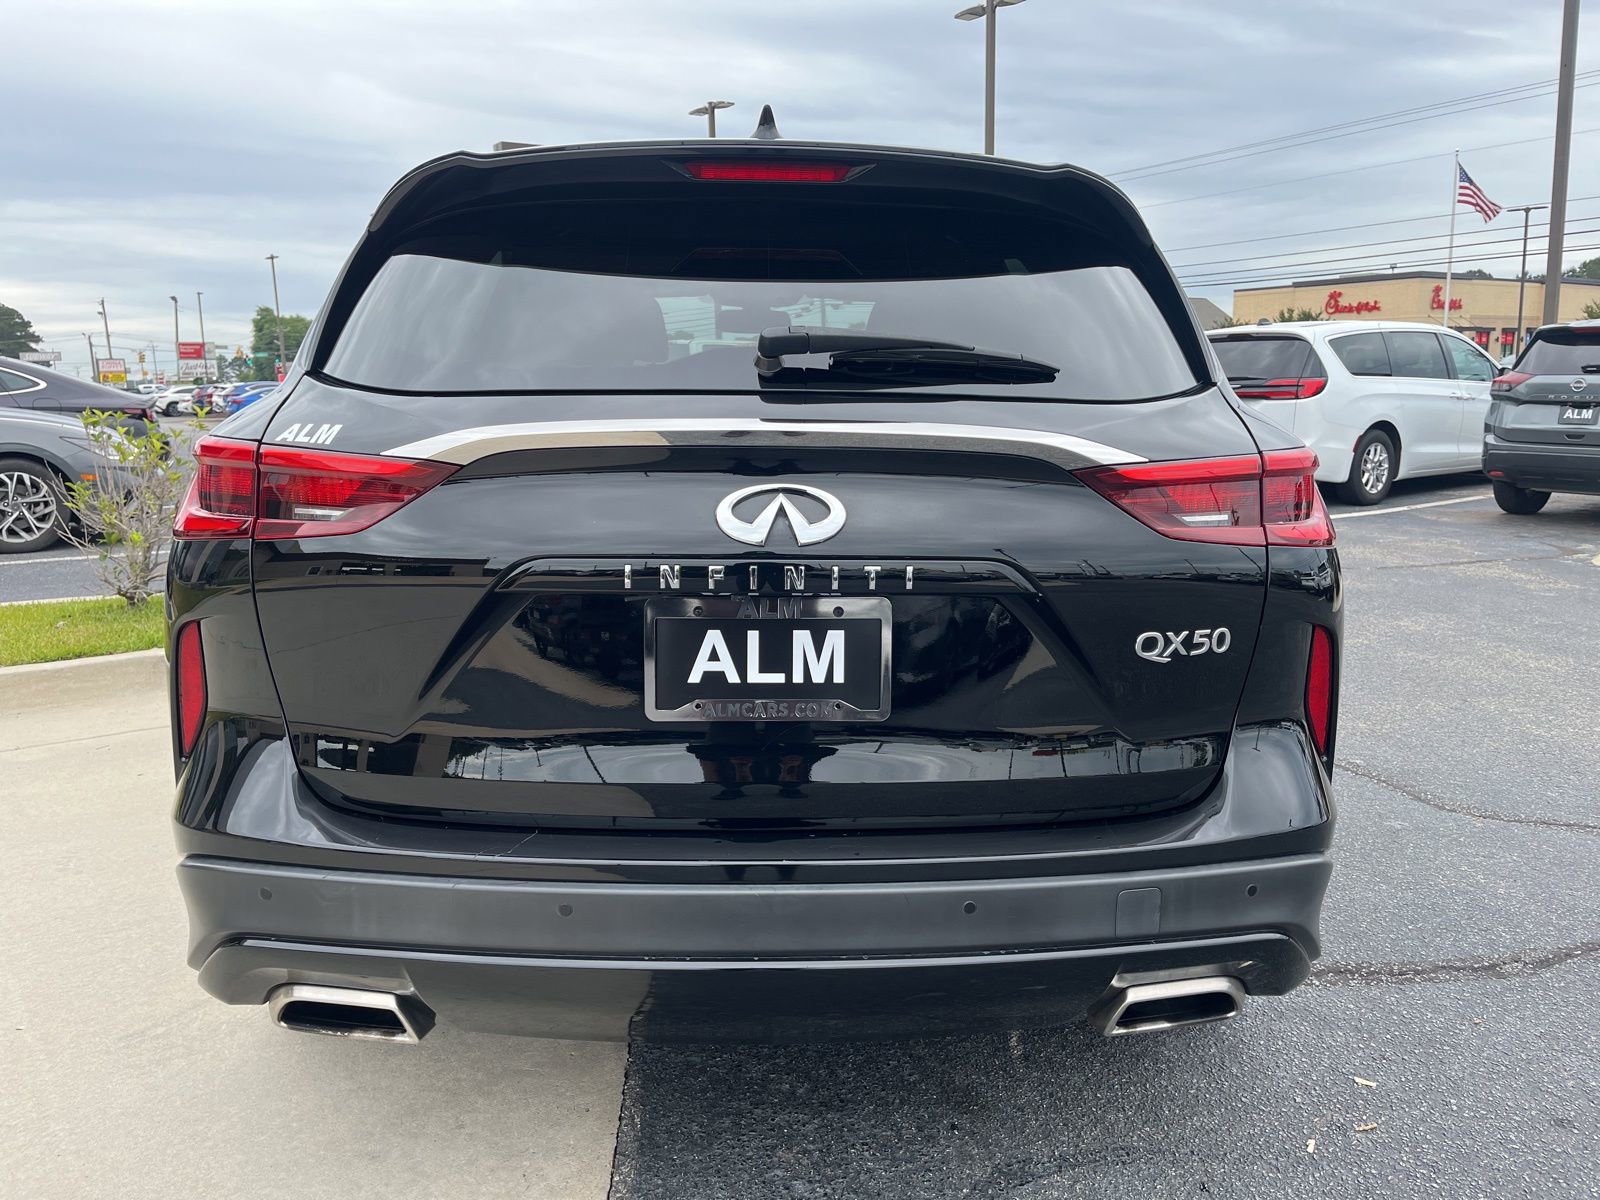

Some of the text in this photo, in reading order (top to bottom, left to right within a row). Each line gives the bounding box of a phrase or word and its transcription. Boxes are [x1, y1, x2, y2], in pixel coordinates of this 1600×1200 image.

[1563, 409, 1593, 419] ALM
[275, 423, 343, 445] ALM
[624, 564, 914, 590] INFINITI
[687, 629, 845, 684] ALM
[1135, 627, 1231, 664] QX50
[702, 702, 834, 718] ALMCARS.COM
